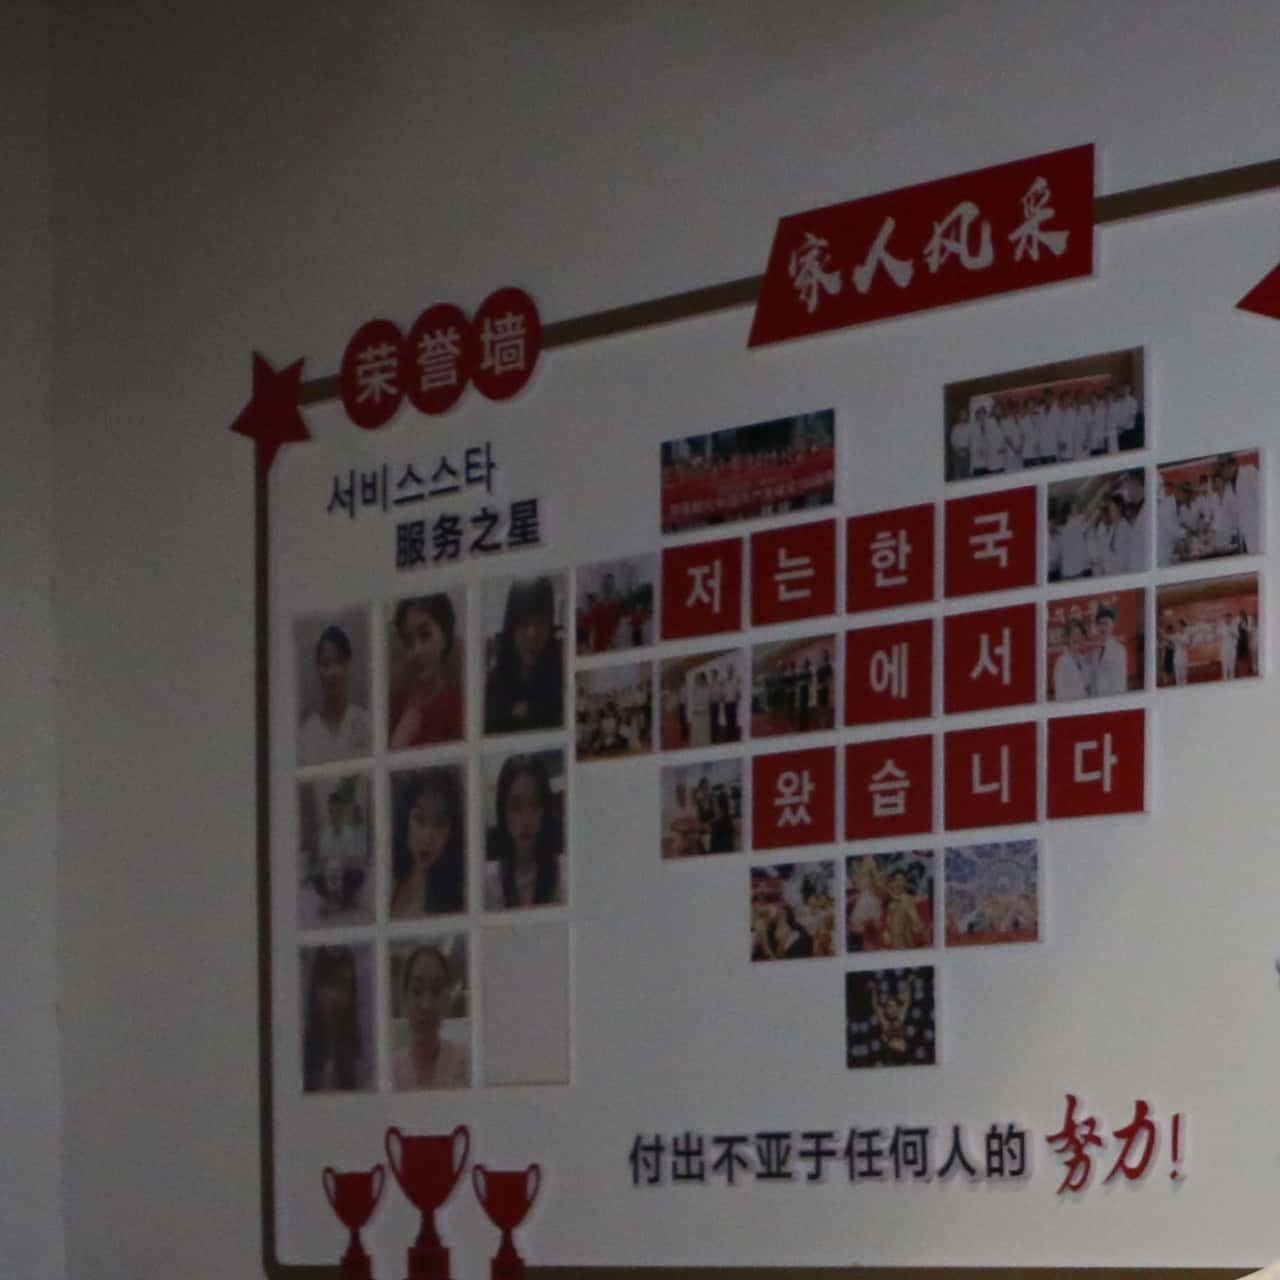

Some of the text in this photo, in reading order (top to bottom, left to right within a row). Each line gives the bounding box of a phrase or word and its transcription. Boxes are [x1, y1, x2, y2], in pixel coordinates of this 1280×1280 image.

[787, 175, 1071, 313] 家人风采
[355, 311, 528, 401] 荣誉墙
[326, 441, 497, 519] 서비스스타
[394, 498, 541, 572] 服务之星
[627, 1122, 1028, 1188] 付出不亚于任何人的
